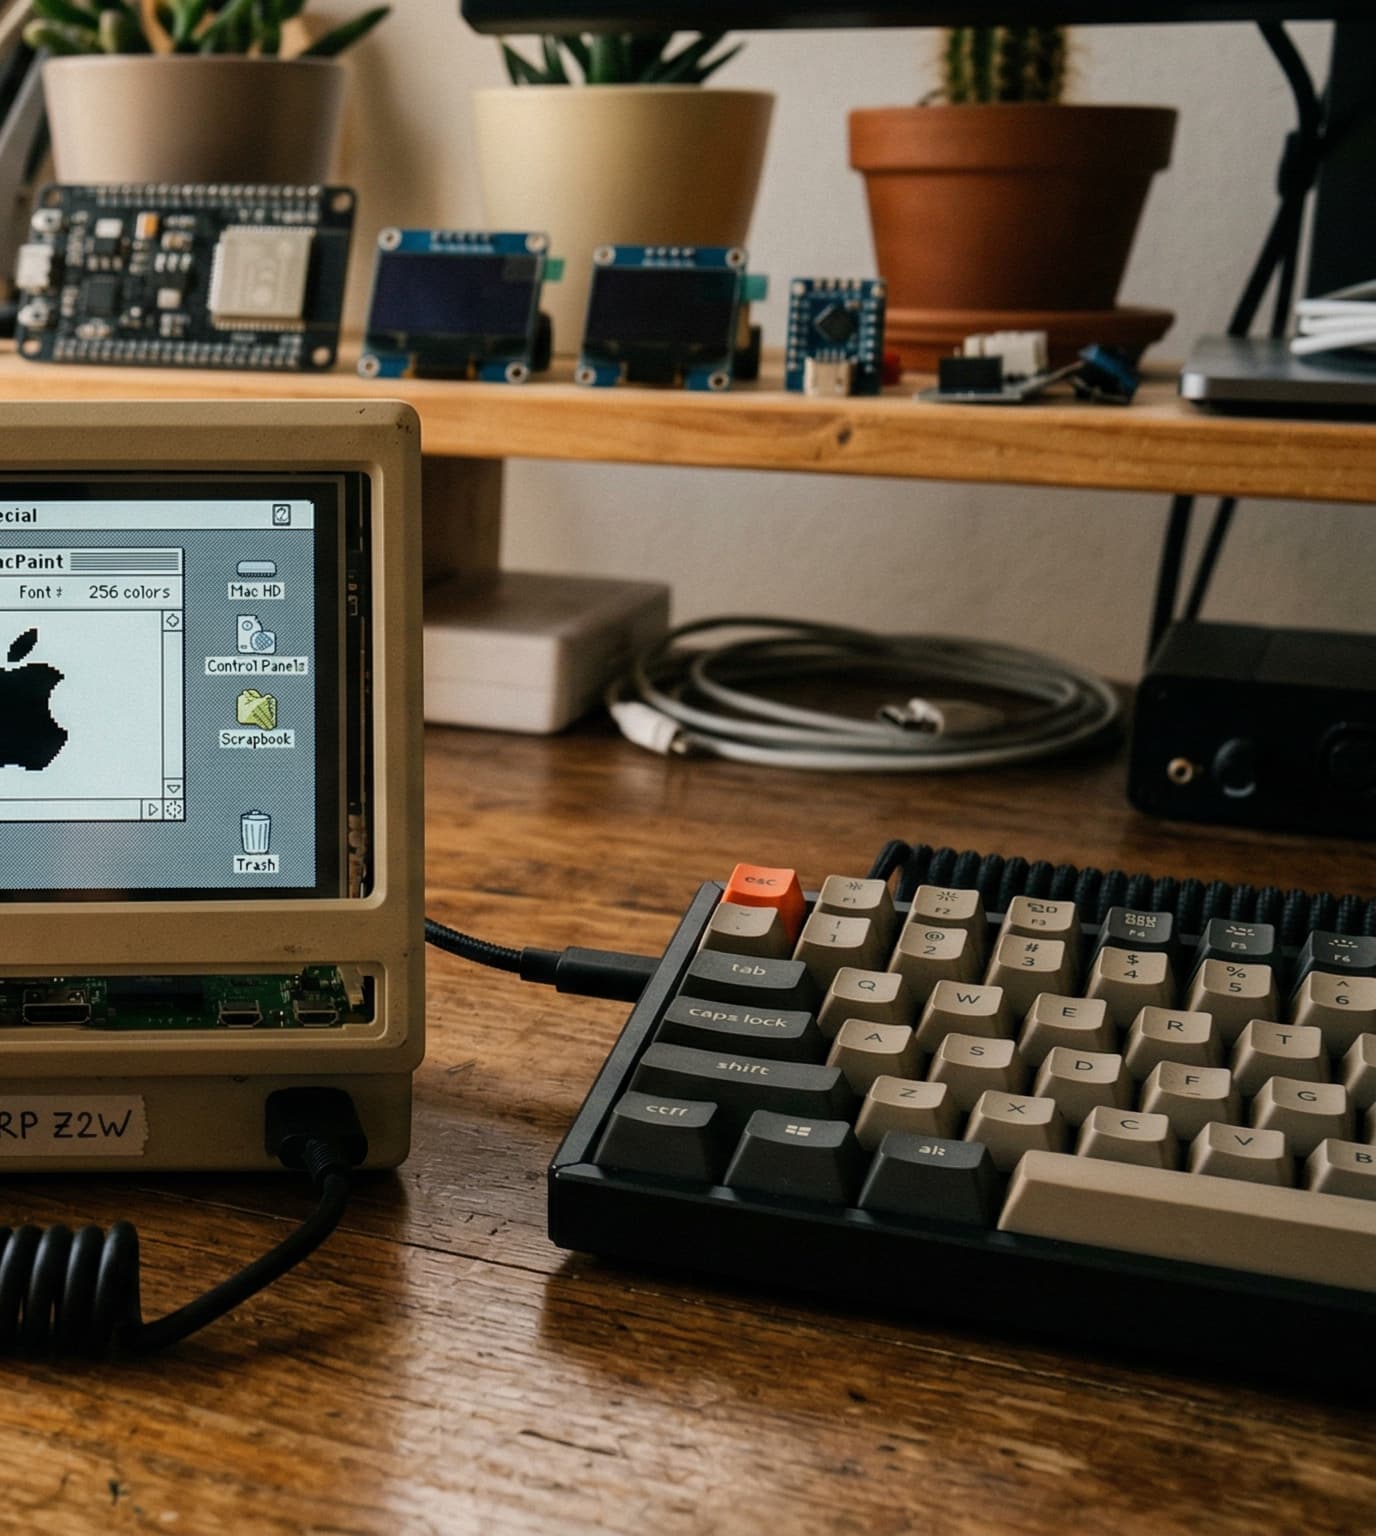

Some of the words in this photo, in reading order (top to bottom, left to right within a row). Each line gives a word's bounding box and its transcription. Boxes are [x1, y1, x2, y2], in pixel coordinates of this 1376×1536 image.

[20, 585, 50, 598] Font
[90, 585, 118, 598] 256
[124, 585, 170, 598] colors
[231, 585, 257, 597] Mac
[264, 585, 280, 597] HD
[208, 660, 257, 672] Control
[262, 659, 304, 671] Panels
[222, 733, 290, 748] Scrapbook
[237, 858, 275, 871] Trash
[934, 907, 951, 915] F2
[924, 931, 945, 941] @
[922, 945, 937, 955] 2
[1025, 942, 1039, 953] #
[1021, 956, 1035, 967] 3
[1127, 954, 1139, 966] $
[731, 963, 767, 976] tab
[1123, 969, 1138, 979] 4
[1226, 966, 1247, 979] %
[857, 979, 877, 992] Q
[1228, 982, 1242, 993] 5
[956, 992, 981, 1005] W
[1335, 995, 1350, 1005] 6
[688, 1008, 739, 1022] caps
[743, 1014, 787, 1028] lock
[1062, 1006, 1077, 1018] E
[1167, 1019, 1184, 1032] R
[863, 1032, 883, 1043] A
[1275, 1033, 1293, 1045] T
[969, 1045, 985, 1056] S
[716, 1061, 771, 1076] shift
[1074, 1060, 1094, 1071] D
[1185, 1075, 1199, 1086] F
[898, 1087, 918, 1099] Z
[1296, 1090, 1317, 1102] G
[1007, 1102, 1026, 1114] X
[53, 1110, 132, 1138] Z2W
[1119, 1119, 1139, 1130] C
[1233, 1134, 1254, 1146] V
[1355, 1152, 1373, 1164] B
